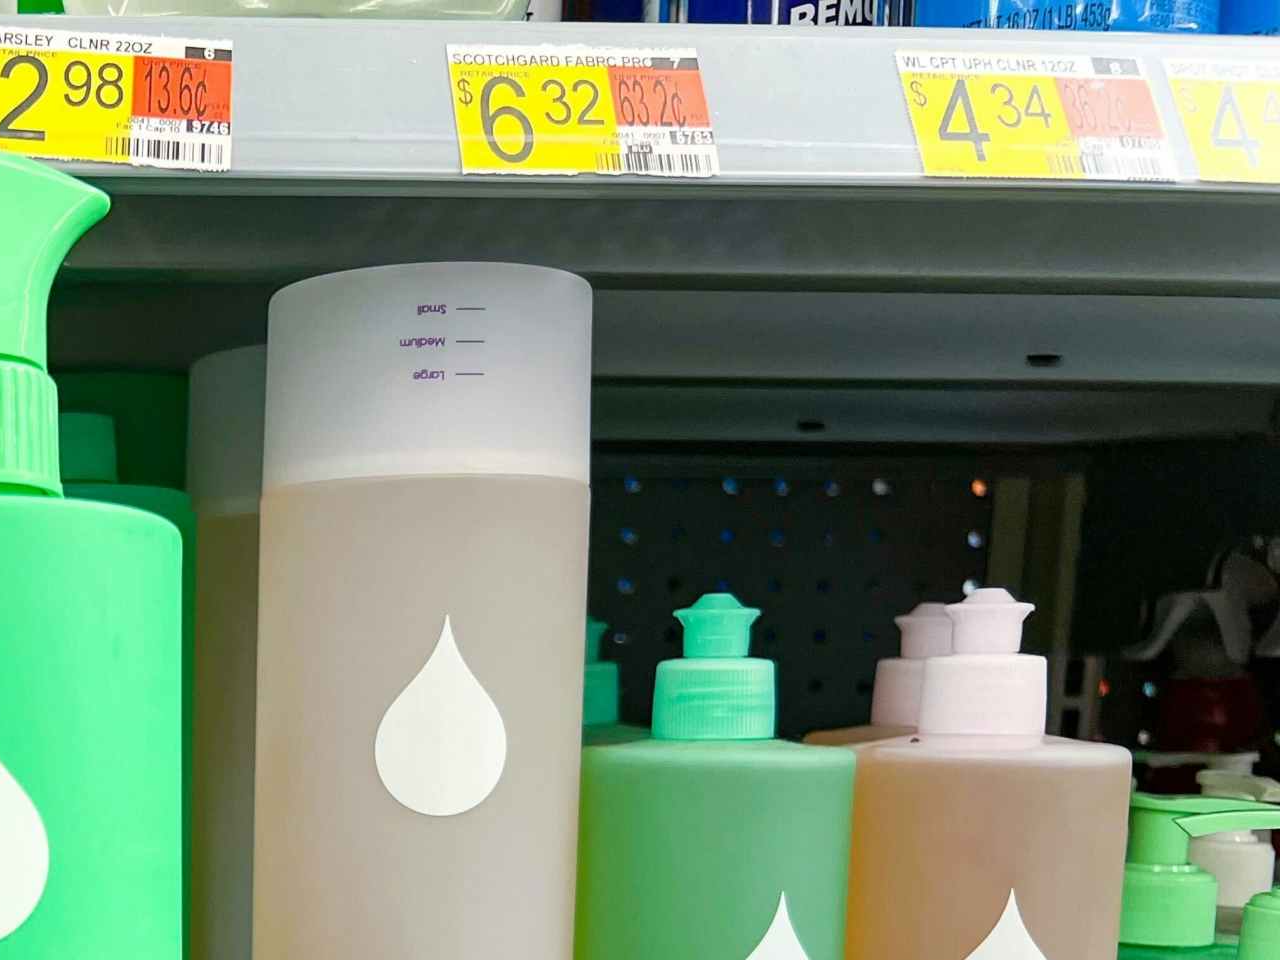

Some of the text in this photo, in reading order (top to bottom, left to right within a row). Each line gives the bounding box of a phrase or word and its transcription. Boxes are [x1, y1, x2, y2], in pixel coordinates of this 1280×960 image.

[1080, 1, 1113, 31] 453g
[68, 36, 110, 51] CLNR
[116, 40, 153, 54] 22OZ
[453, 53, 561, 67] SCOTCHGARD
[565, 55, 617, 68] FABRC
[903, 56, 927, 69] WL
[929, 57, 957, 70] CPT
[962, 58, 992, 71] UPH
[996, 59, 1037, 72] CLNR
[191, 120, 231, 136] 9746
[675, 130, 714, 145] 6783
[417, 304, 447, 316] Small
[399, 337, 446, 348] Medium
[413, 369, 445, 381] Large
